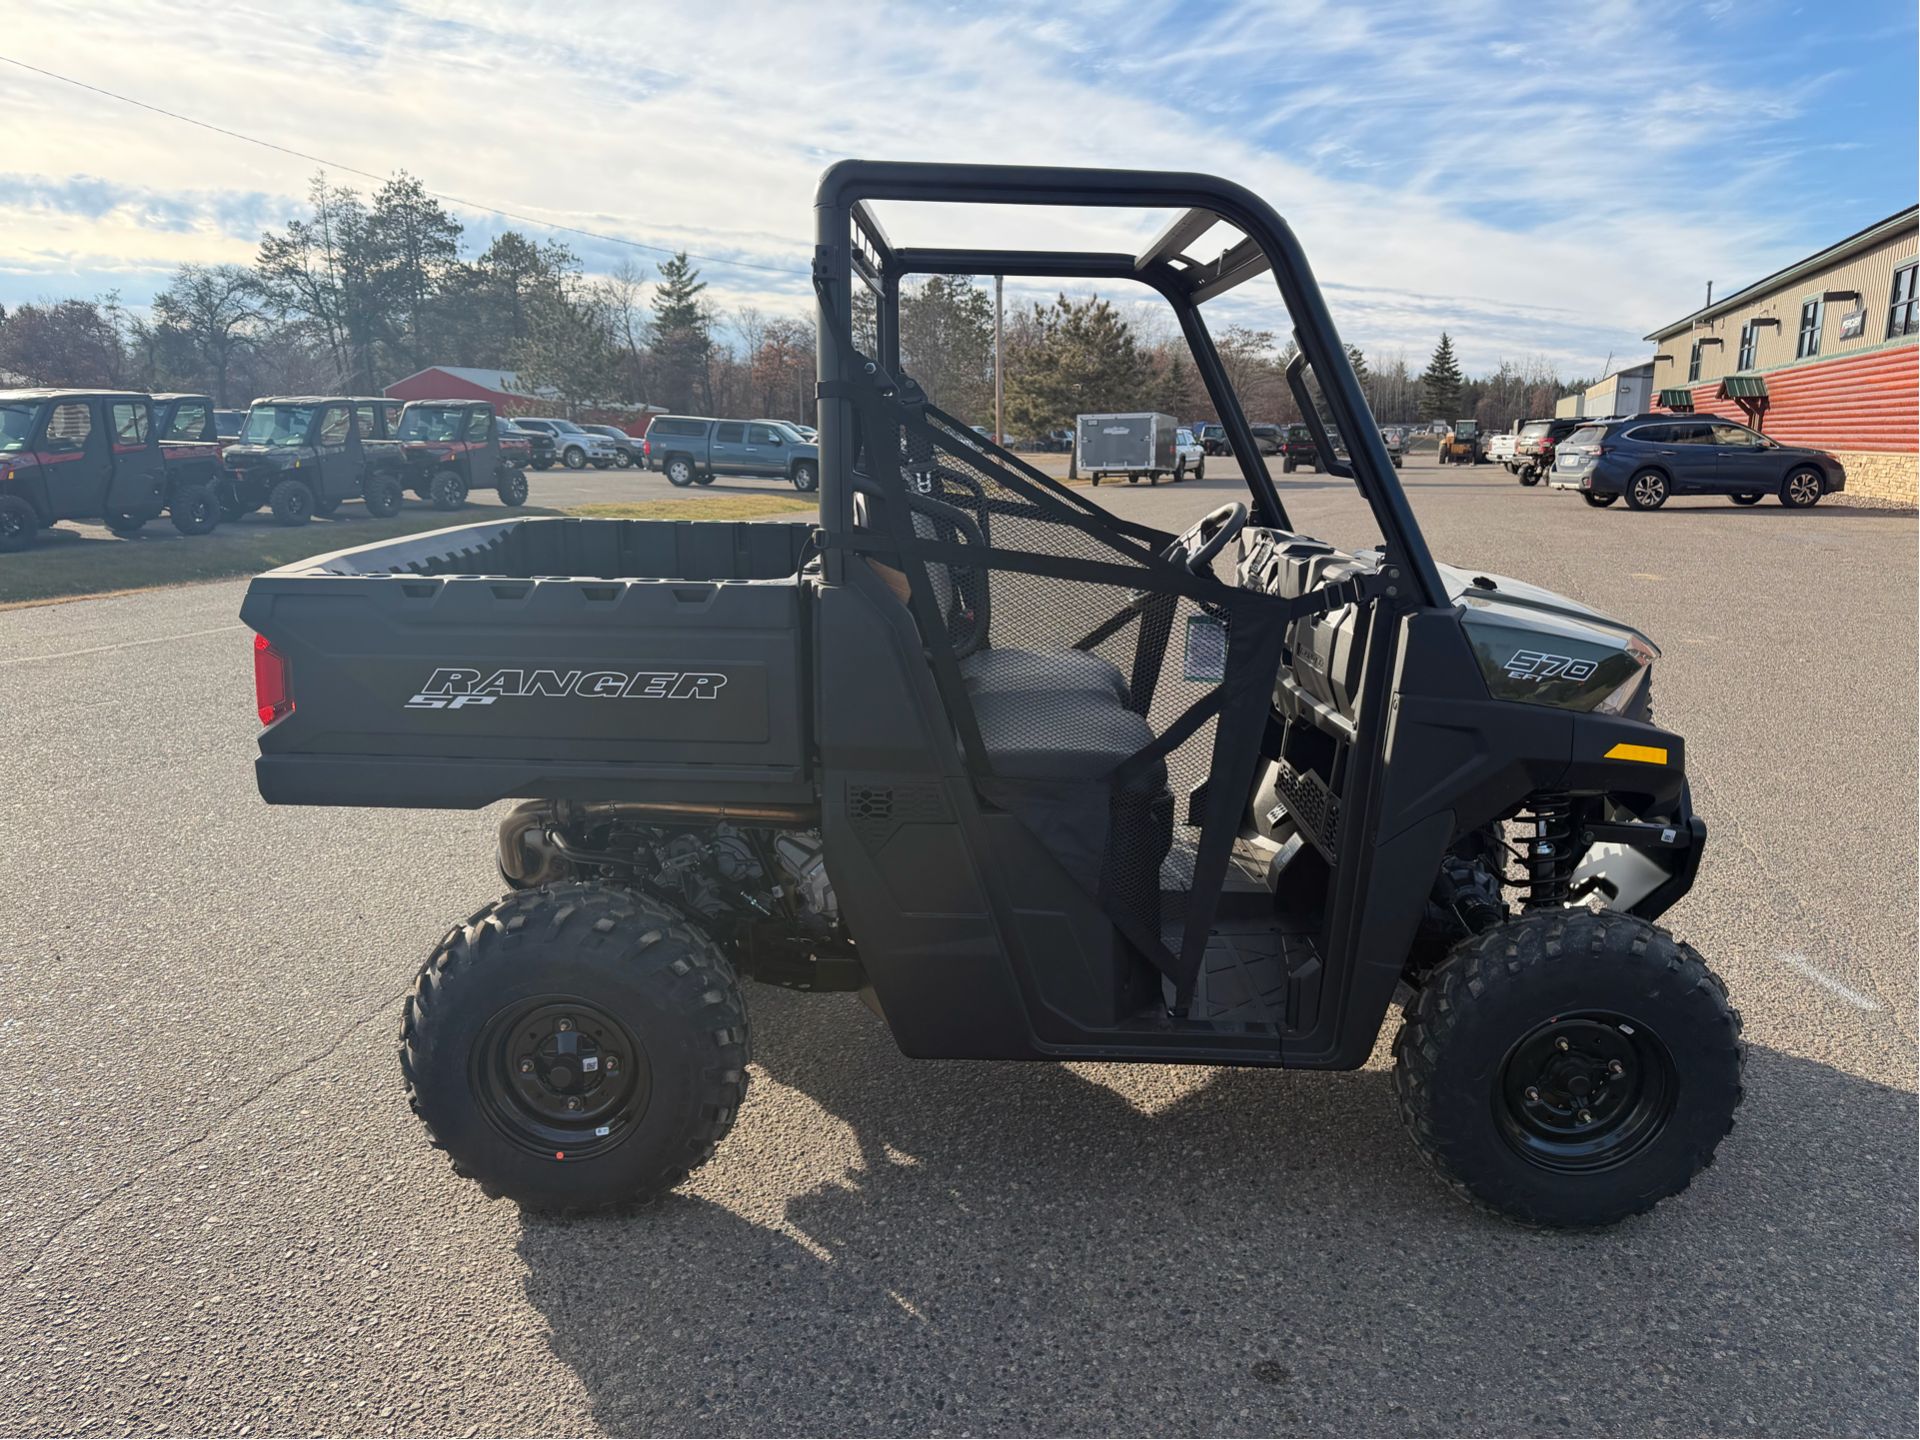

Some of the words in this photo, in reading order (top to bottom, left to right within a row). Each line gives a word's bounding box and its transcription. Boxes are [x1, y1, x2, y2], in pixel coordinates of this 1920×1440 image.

[1504, 649, 1598, 681] 570
[421, 668, 728, 699] RANGER
[1508, 671, 1542, 682] EFI
[404, 695, 497, 709] SP
